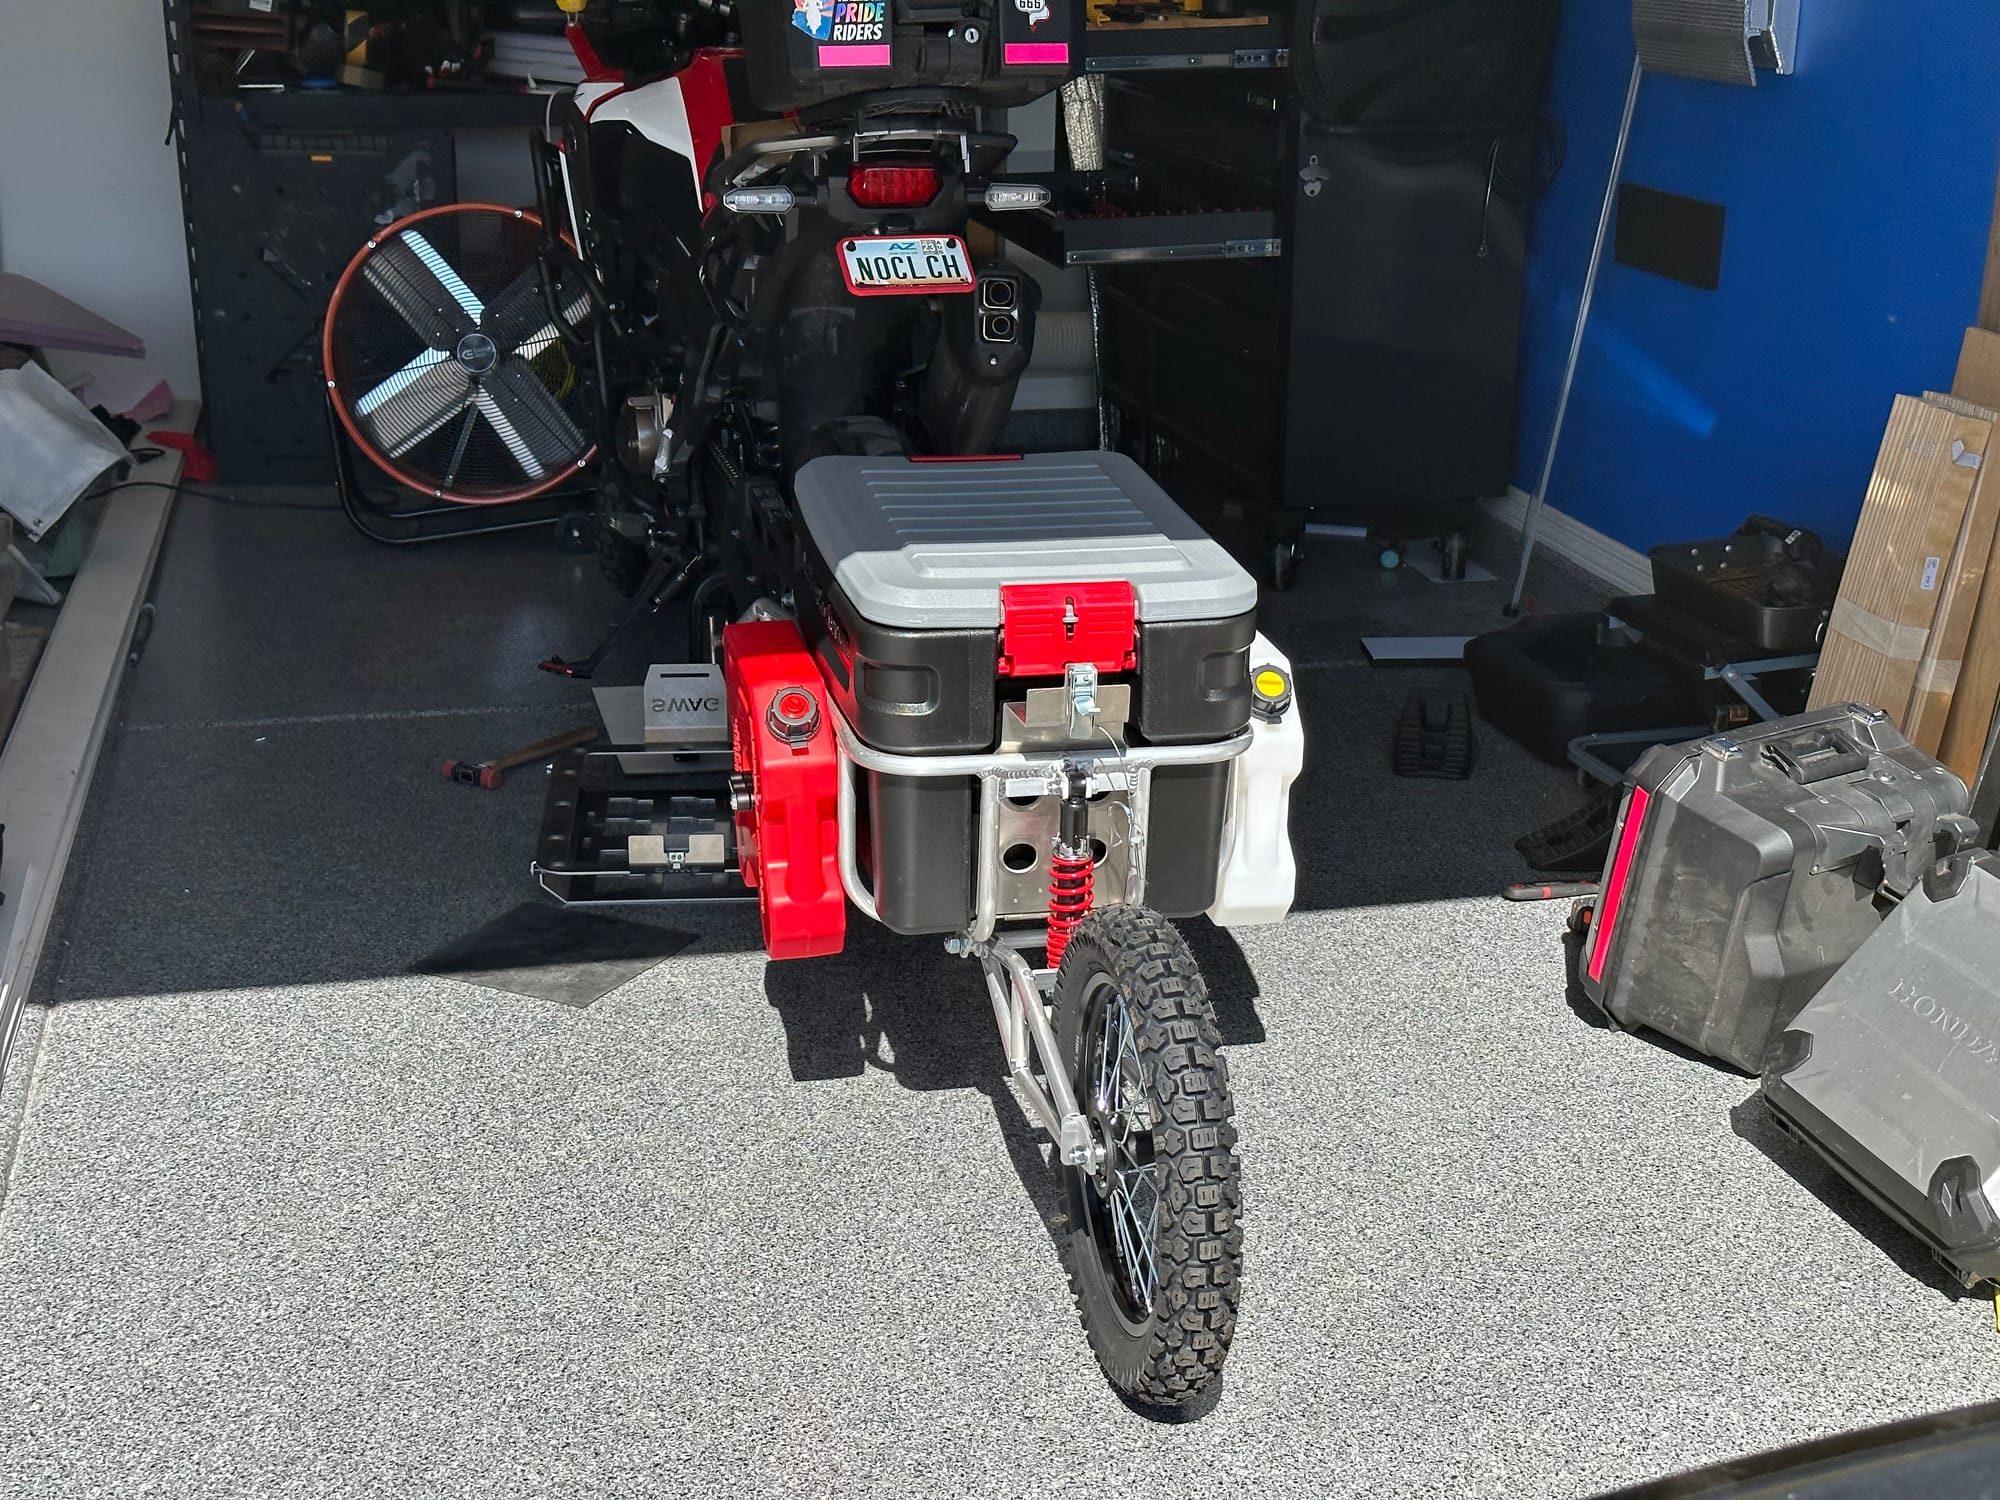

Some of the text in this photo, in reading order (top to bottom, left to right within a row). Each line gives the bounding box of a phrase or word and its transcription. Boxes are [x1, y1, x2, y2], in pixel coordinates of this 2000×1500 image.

[834, 2, 886, 23] PRIDE
[833, 23, 884, 41] RIDERS
[888, 242, 917, 251] AZ
[922, 243, 936, 252] 23
[856, 254, 962, 281] NOCLCH
[1888, 977, 1999, 1064] HONDA
